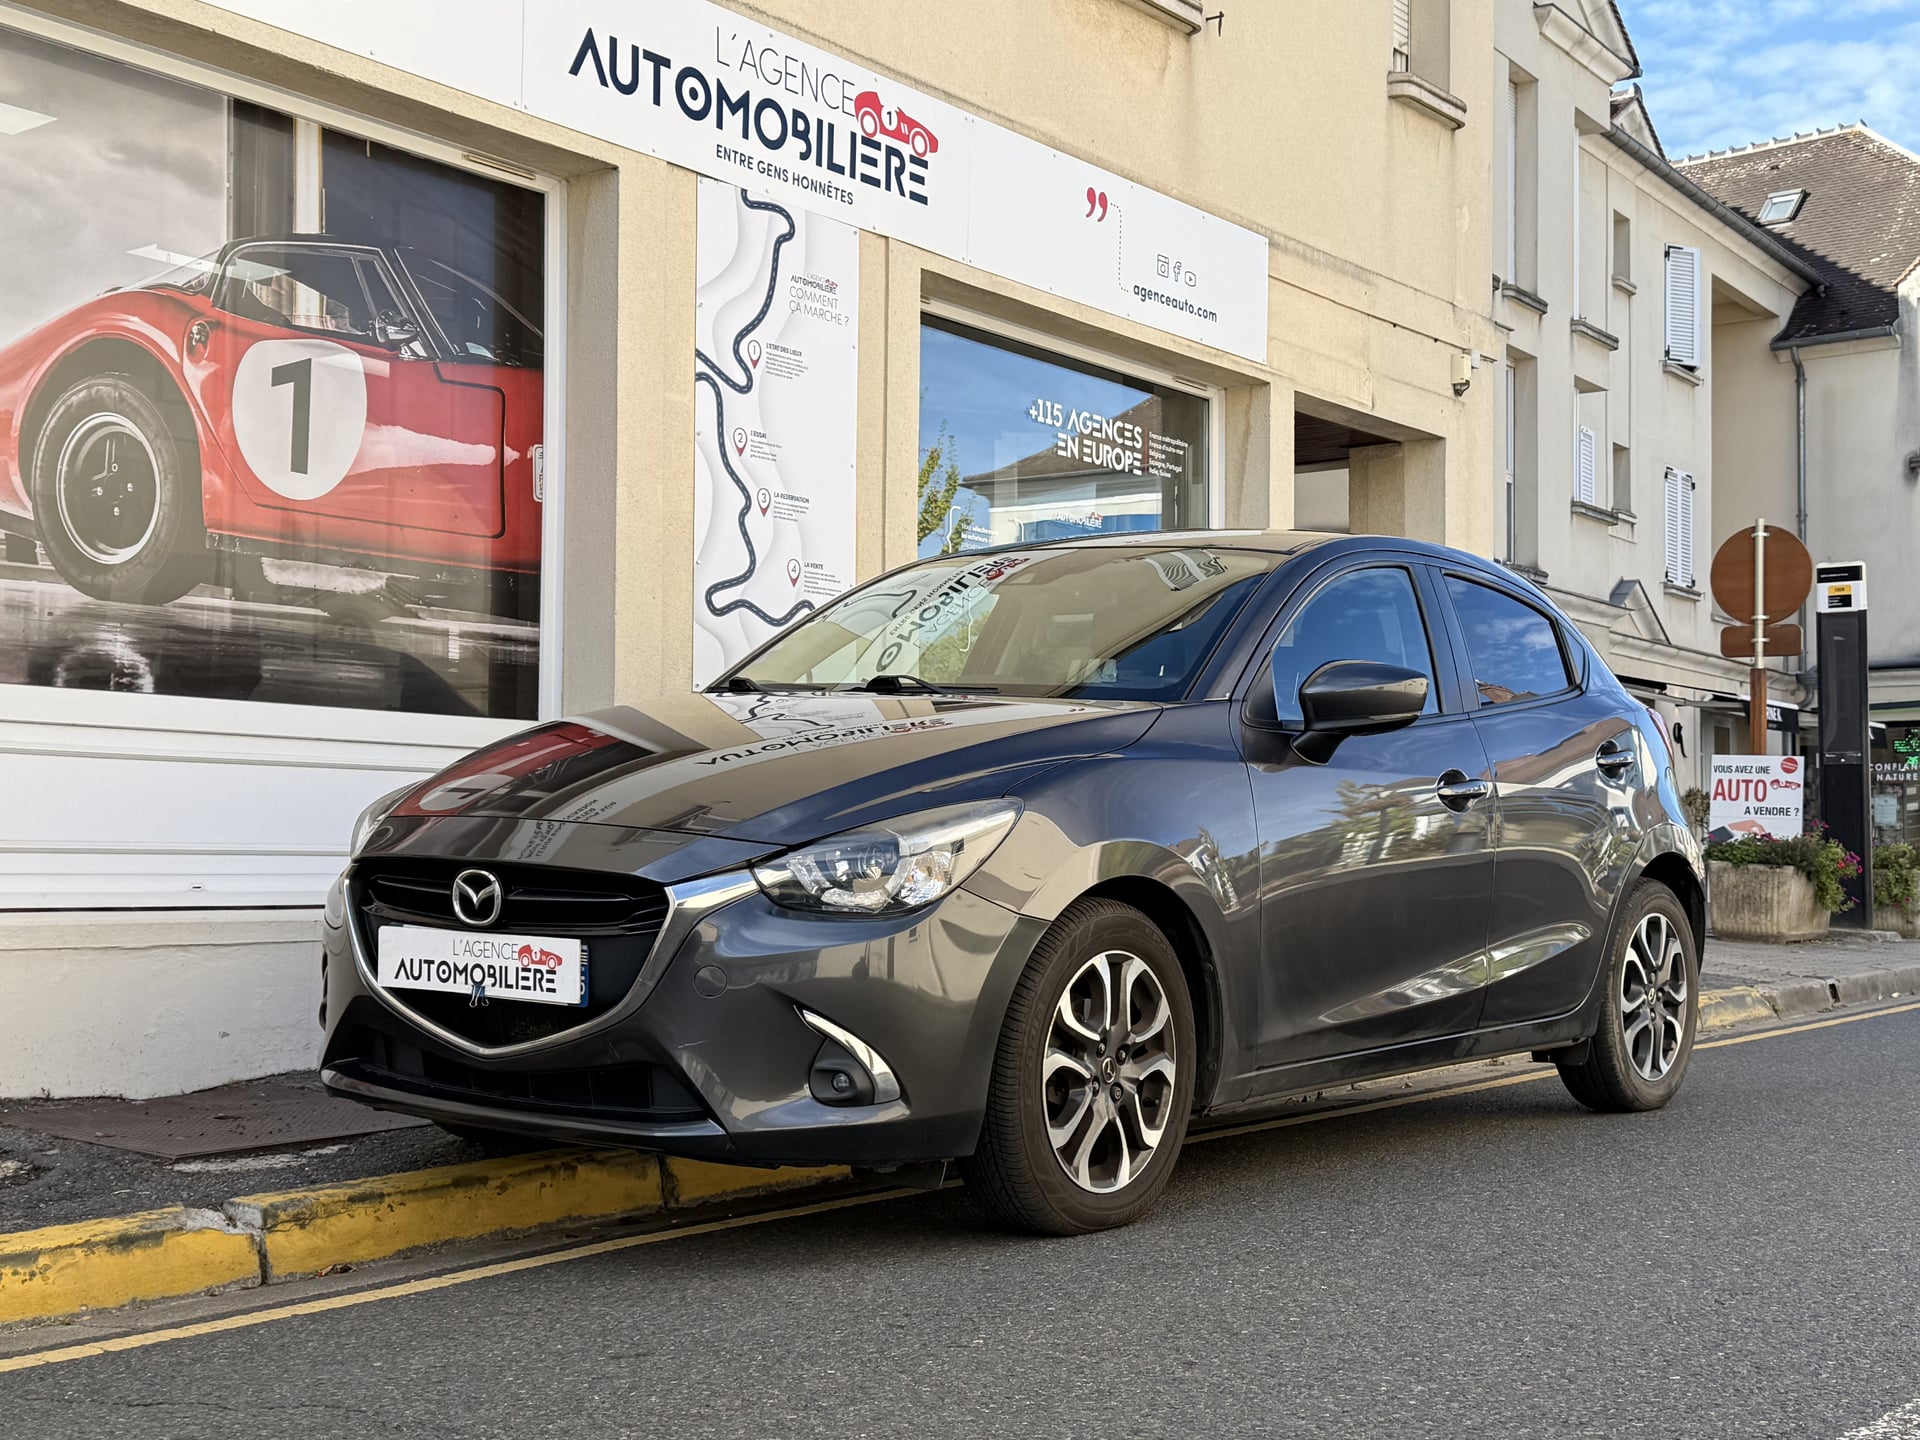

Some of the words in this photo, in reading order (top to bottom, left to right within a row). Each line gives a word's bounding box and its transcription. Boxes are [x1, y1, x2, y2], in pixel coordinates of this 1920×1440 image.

[716, 26, 856, 117] L'AGENCE
[716, 143, 754, 170] ENTRE
[757, 159, 789, 183] GENS
[792, 173, 854, 205] HONNÊTES
[789, 285, 839, 310] COMMENT
[1132, 284, 1218, 323] agenceauto.com
[789, 300, 802, 315] ÇA
[803, 303, 843, 326] MARCHE
[844, 315, 850, 327] ?
[272, 357, 312, 475] 1
[1029, 399, 1063, 428] +115
[1067, 408, 1143, 449] AGENCES
[737, 432, 744, 444] 2
[1057, 432, 1079, 460] EN
[1082, 439, 1143, 476] EUROPE
[761, 492, 767, 504] 3
[773, 491, 780, 499] LA
[791, 563, 797, 574] 4
[1713, 764, 1733, 774] VOUS
[1734, 765, 1753, 774] AVEZ
[1755, 765, 1771, 775] UNE
[1876, 773, 1919, 782] NATURE
[1712, 778, 1768, 803] AUTO
[1743, 805, 1752, 816] A
[1753, 806, 1792, 817] VENDRE
[1793, 807, 1800, 817] ?
[452, 938, 519, 961] L'AGENCE
